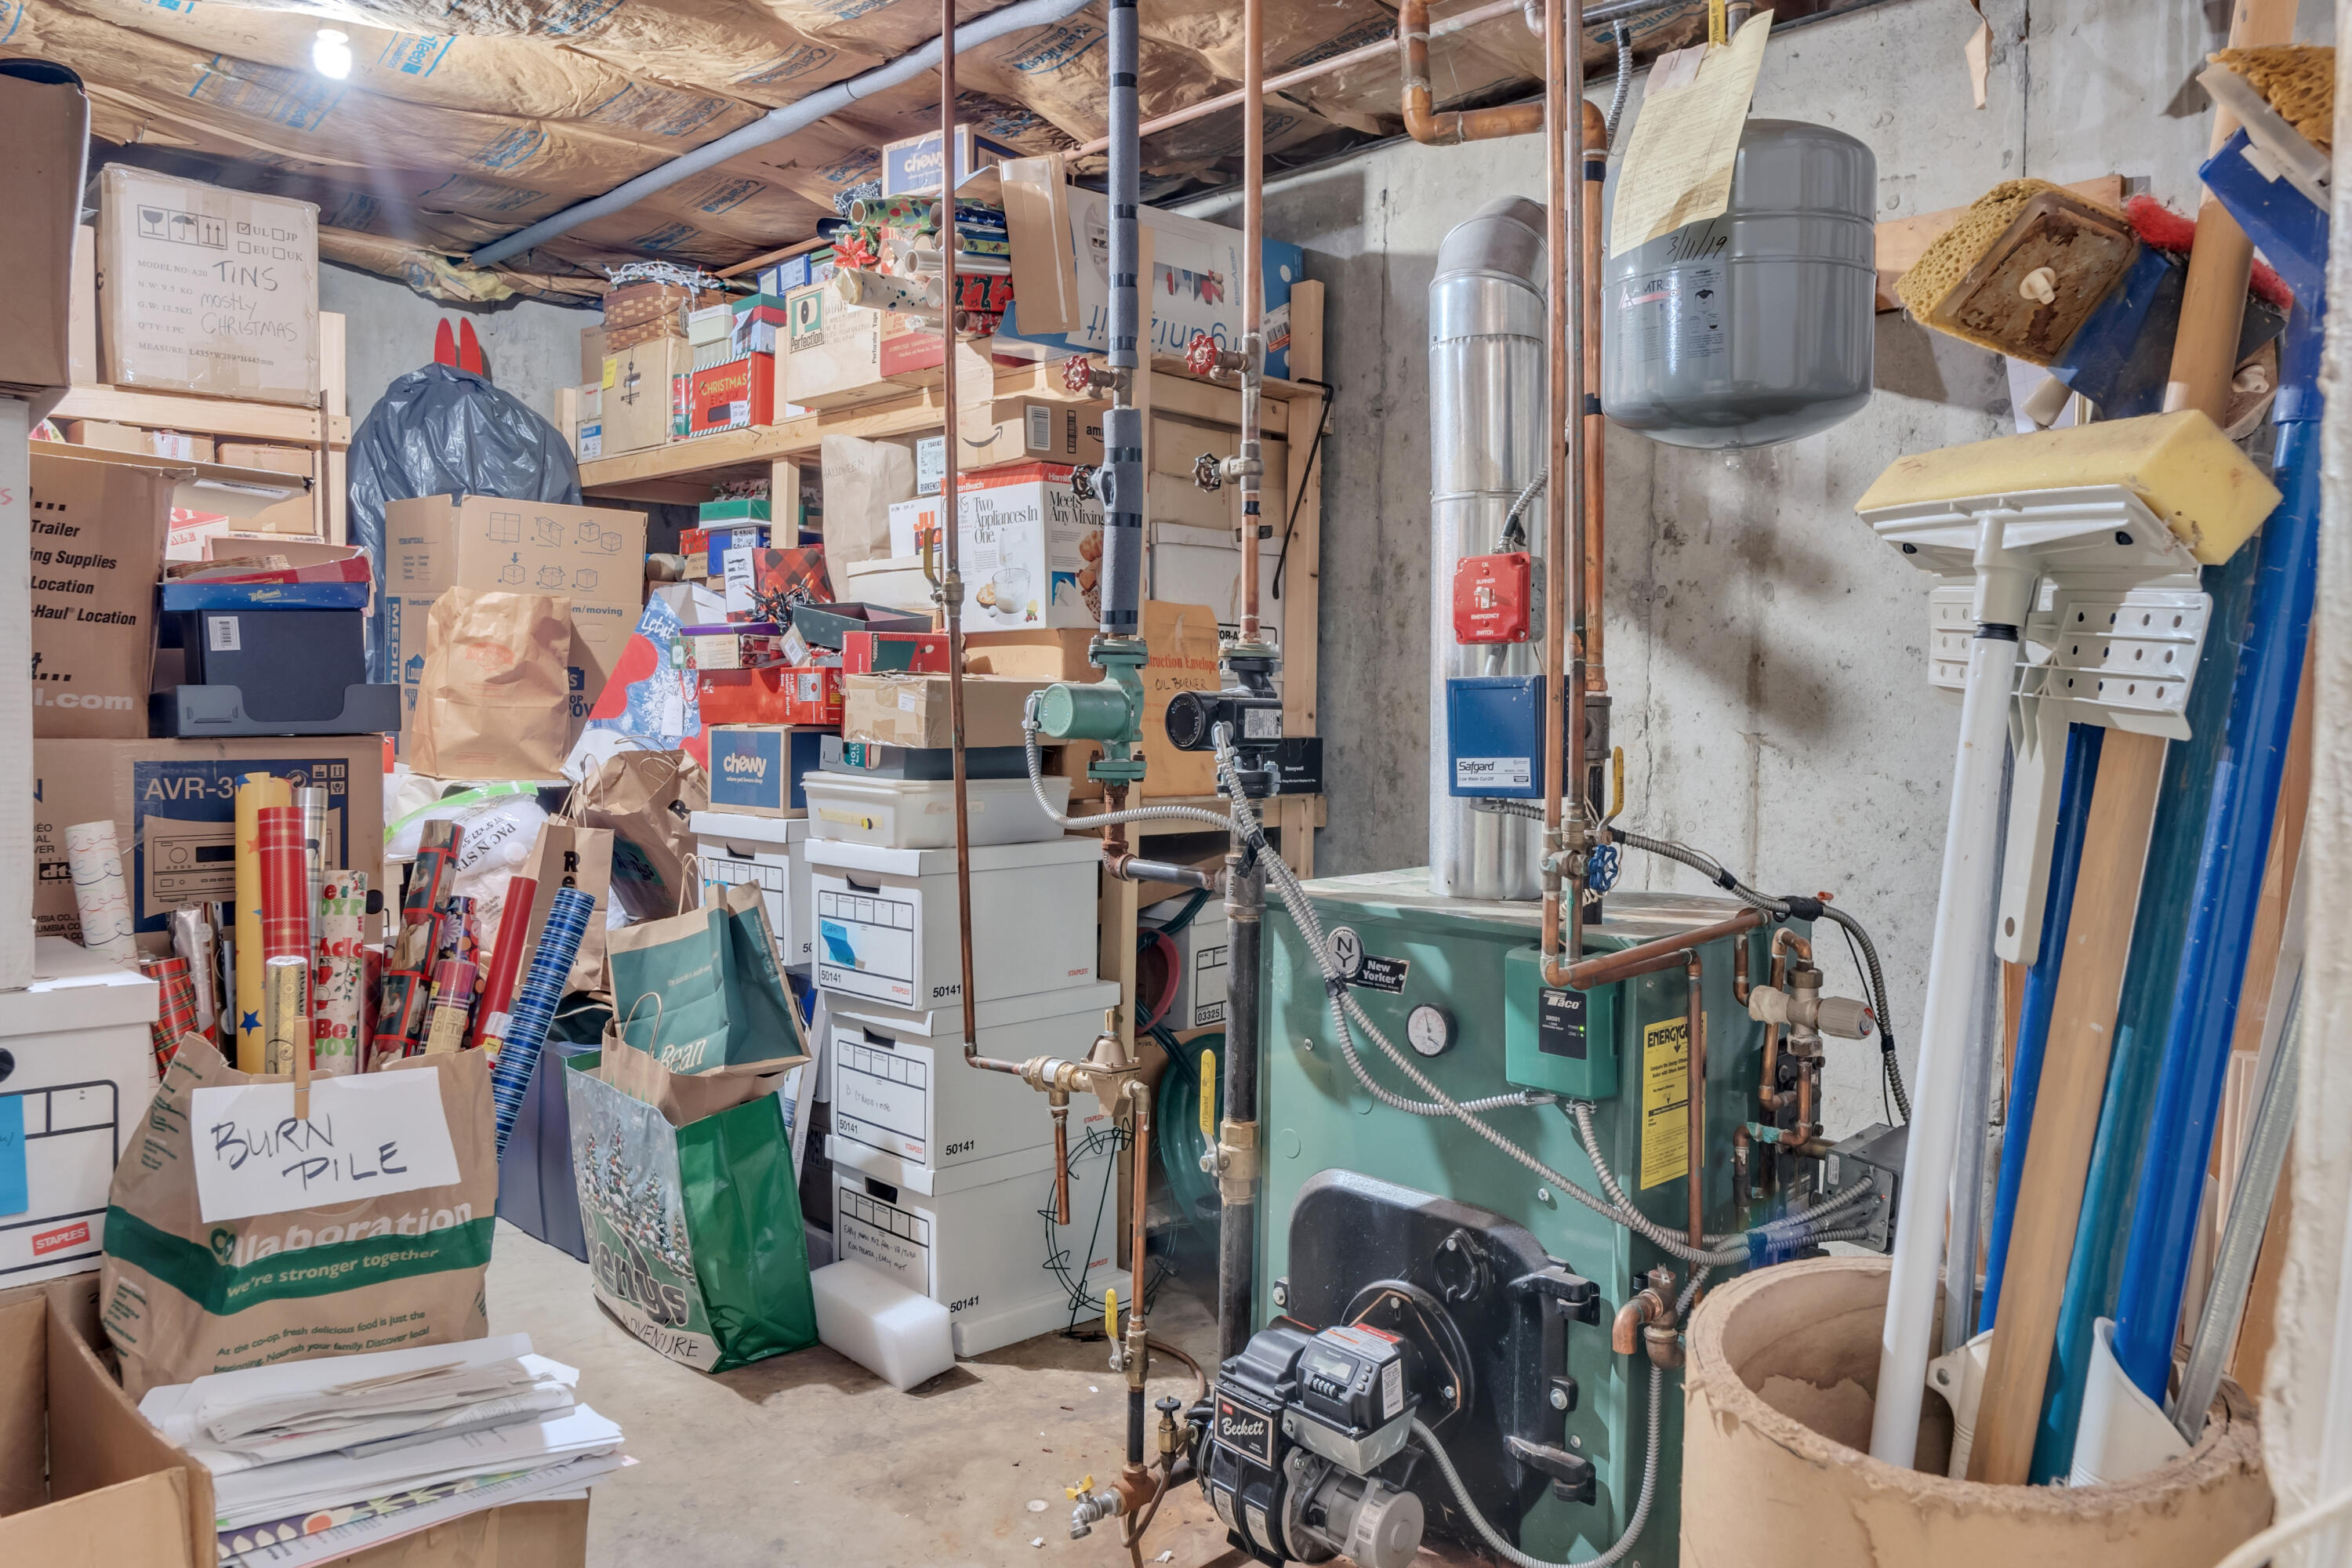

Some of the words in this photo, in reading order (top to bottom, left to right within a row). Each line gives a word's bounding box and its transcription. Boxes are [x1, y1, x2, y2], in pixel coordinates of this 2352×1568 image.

[253, 227, 269, 238] UL
[286, 230, 298, 241] JP
[1667, 220, 1728, 263] 3/11/19
[253, 245, 269, 256] EU
[287, 251, 303, 262] UK
[138, 260, 172, 272] MODEL
[212, 260, 278, 291] TINS
[180, 287, 193, 296] KG
[201, 313, 297, 342] CHRISTMAS
[138, 342, 187, 354] MEASURE:
[790, 332, 823, 352] Perfection
[700, 372, 747, 396] CHRISTMAS
[1086, 426, 1104, 437] am
[967, 481, 984, 491] Beach
[974, 496, 993, 513] Two
[1050, 491, 1083, 509] Meets
[975, 510, 1026, 531] Appliances
[1028, 506, 1038, 521] In
[1050, 509, 1071, 525] Any
[1072, 510, 1105, 526] Mixing
[31, 520, 81, 538] Trailer
[975, 528, 996, 544] One.
[56, 550, 118, 570] Supplies
[31, 575, 95, 595] Location
[77, 608, 136, 626] Location
[1185, 655, 1217, 674] Envelope
[1155, 678, 1170, 691] OIL
[1171, 677, 1208, 691] BURNER
[723, 753, 767, 776] chewy
[1458, 761, 1494, 775] Safgard
[492, 823, 516, 844] PAC
[477, 843, 490, 855] N
[1067, 968, 1088, 977] STAPLES
[1367, 960, 1392, 973] New
[821, 970, 841, 983] 50141
[1363, 970, 1397, 984] Yorker
[891, 985, 910, 996] STAPLES
[932, 984, 961, 998] 50141
[1543, 990, 1581, 1010] Taco
[1198, 1008, 1220, 1022] 03325
[839, 1119, 858, 1134] 50141
[1083, 1114, 1105, 1124] STAPLES
[210, 1113, 335, 1171] BURN
[906, 1142, 923, 1155] STAPLES
[946, 1140, 975, 1156] 50141
[282, 1141, 407, 1191] PILE
[36, 1227, 87, 1250] STAPLES
[1087, 1258, 1109, 1269] STAPLES
[227, 1272, 273, 1298] we're
[278, 1258, 358, 1283] stronger
[362, 1248, 440, 1269] together
[950, 1295, 979, 1313] 50141
[234, 1343, 249, 1353] the
[282, 1326, 308, 1338] fresh
[310, 1324, 355, 1335] delicious
[357, 1318, 379, 1331] food
[379, 1318, 387, 1327] is
[389, 1314, 408, 1327] just
[409, 1310, 426, 1320] the
[267, 1343, 304, 1363] Nourish
[307, 1343, 331, 1352] your
[334, 1338, 364, 1352] family.
[365, 1334, 406, 1349] Discover
[409, 1327, 430, 1338] local
